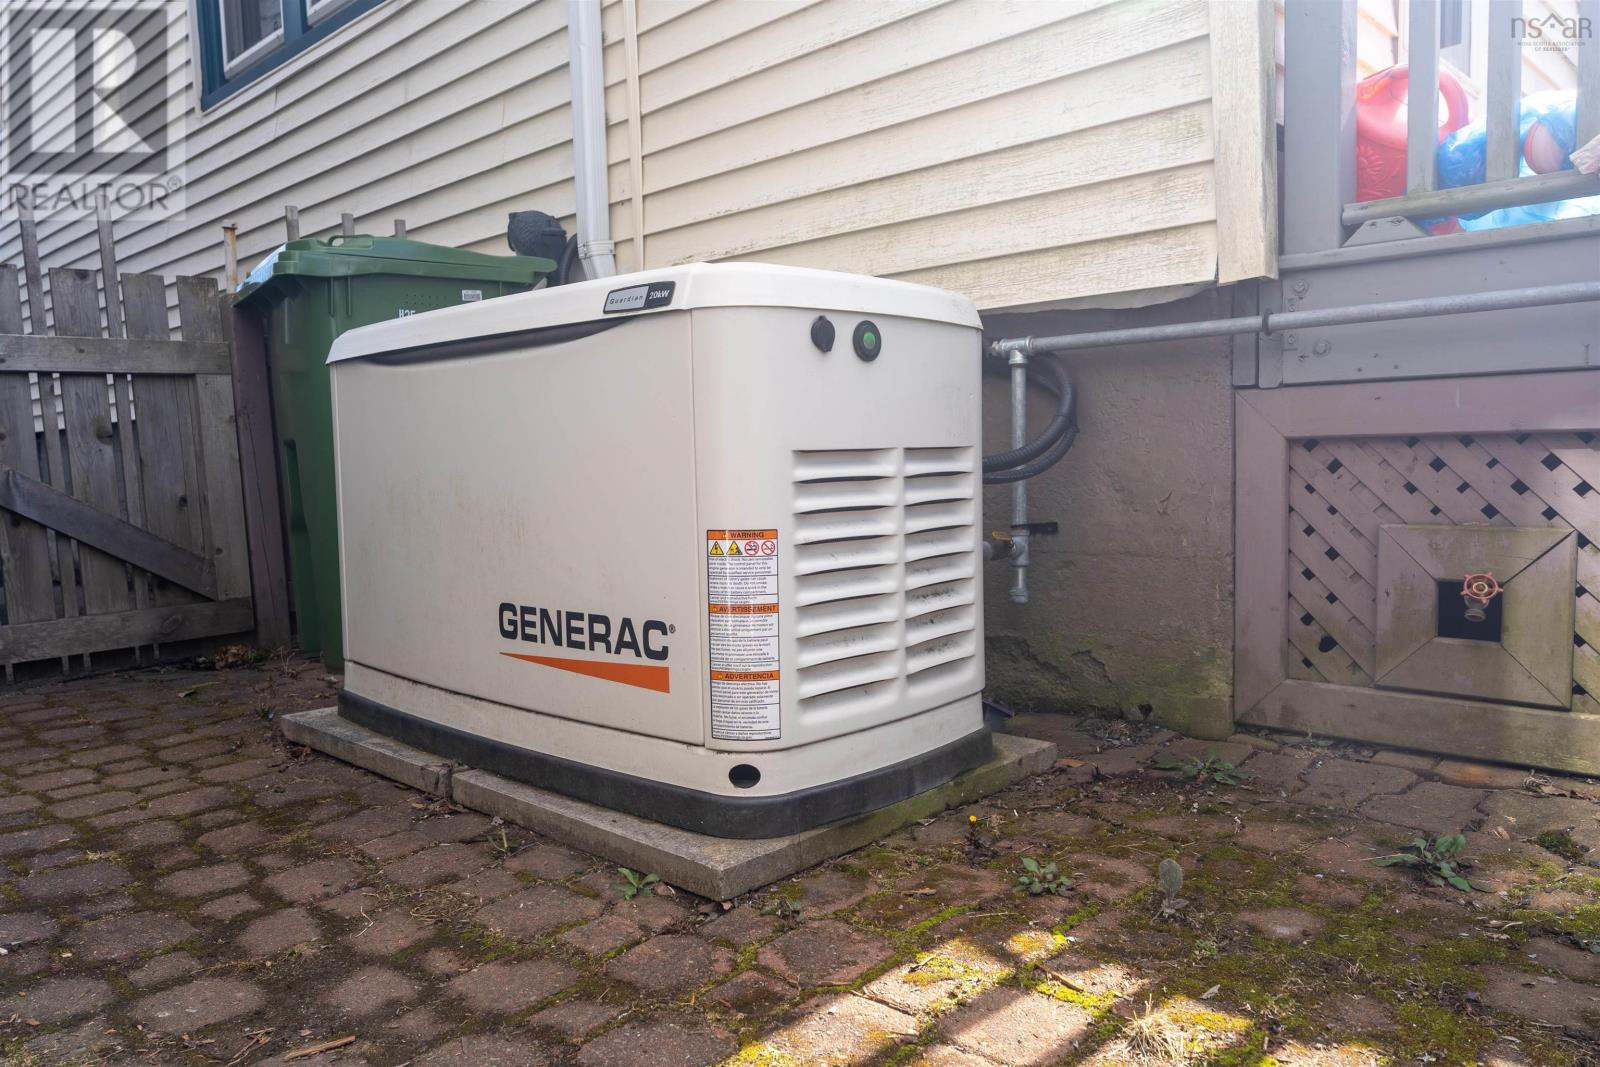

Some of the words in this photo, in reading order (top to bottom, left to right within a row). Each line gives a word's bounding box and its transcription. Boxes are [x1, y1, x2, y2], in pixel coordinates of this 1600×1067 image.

[609, 295, 643, 304] Guardian
[648, 290, 670, 300] 20kW
[725, 672, 774, 680] ADVERTENCIA
